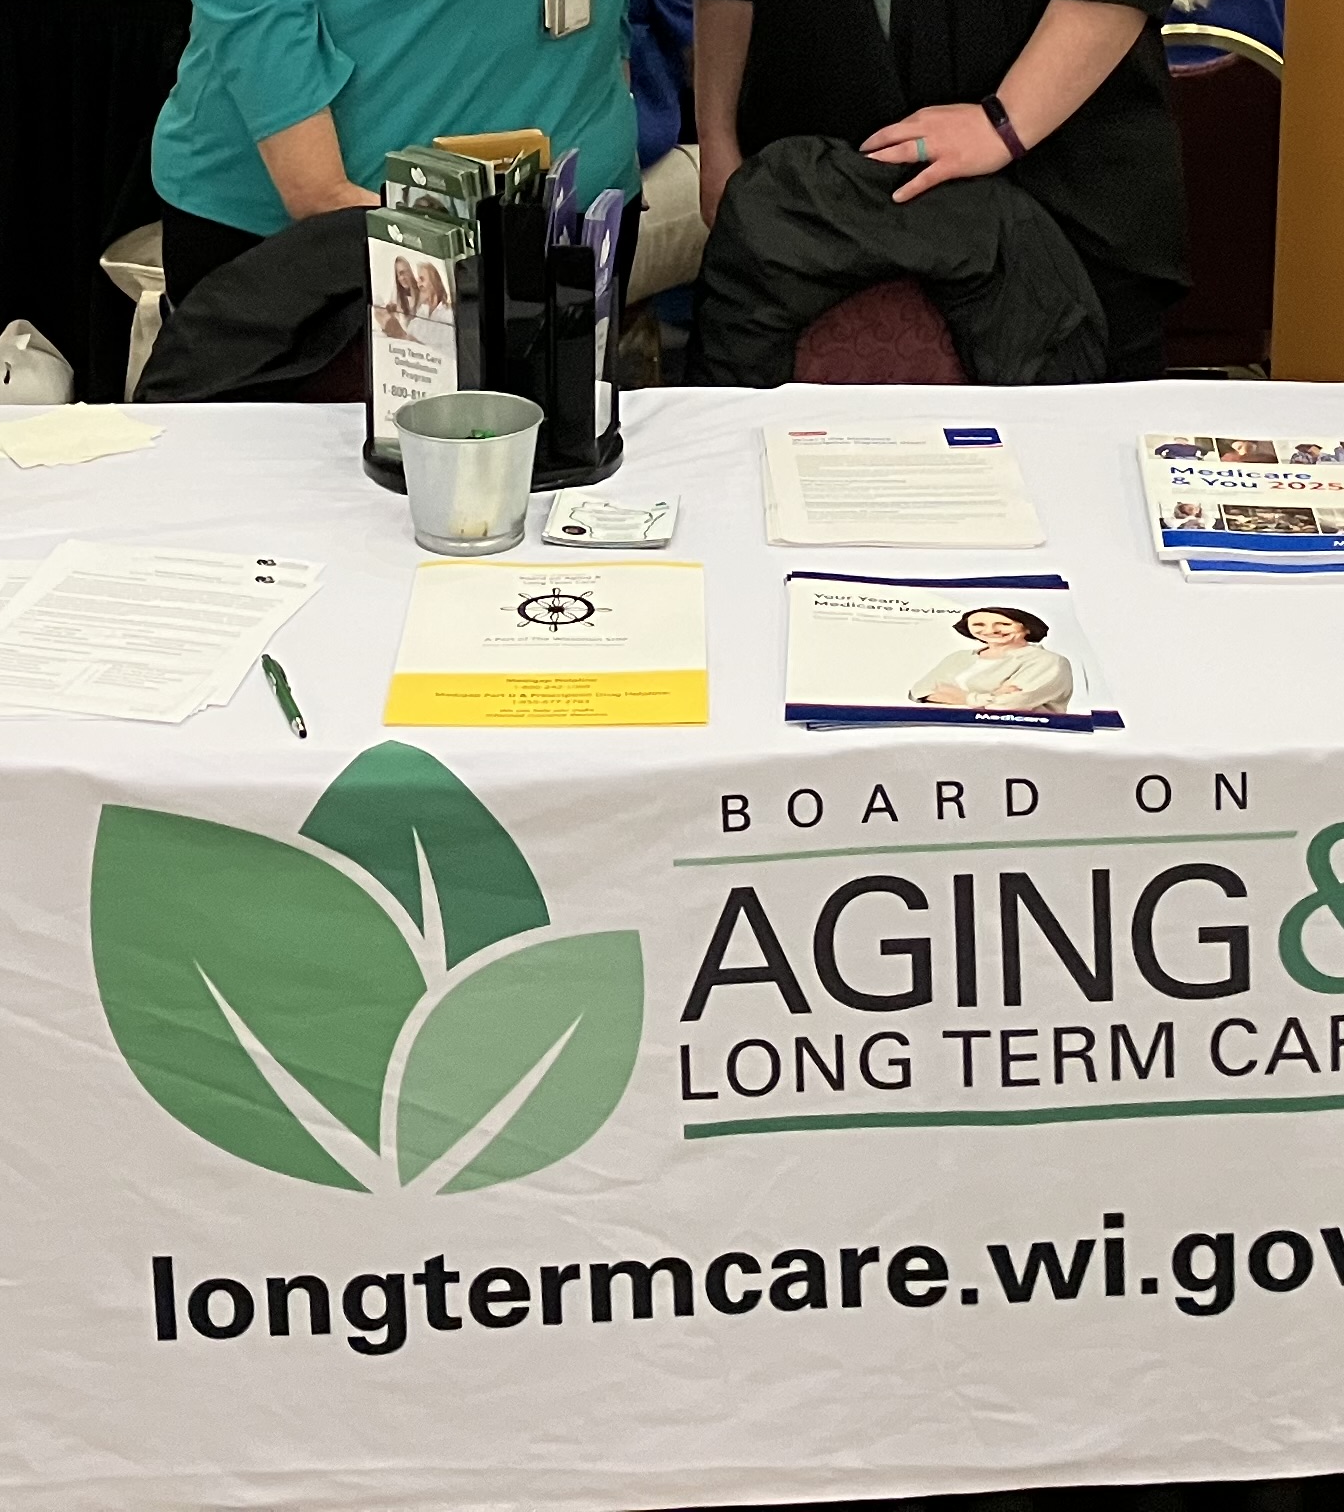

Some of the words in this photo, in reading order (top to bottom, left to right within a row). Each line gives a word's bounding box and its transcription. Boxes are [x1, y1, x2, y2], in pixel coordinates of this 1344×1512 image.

[1170, 467, 1312, 480] Medicare
[1172, 477, 1190, 485] &
[1201, 477, 1258, 489] You
[1268, 481, 1344, 491] 2025
[814, 600, 893, 611] Medicare
[899, 606, 961, 614] Review
[858, 595, 909, 606] Yearly
[975, 713, 1049, 723] Medicare
[720, 777, 1043, 837] BOARD
[1133, 769, 1255, 818] ON
[679, 862, 1254, 1024] AGING
[679, 1029, 914, 1104] LONG
[942, 1020, 1176, 1090] TERM
